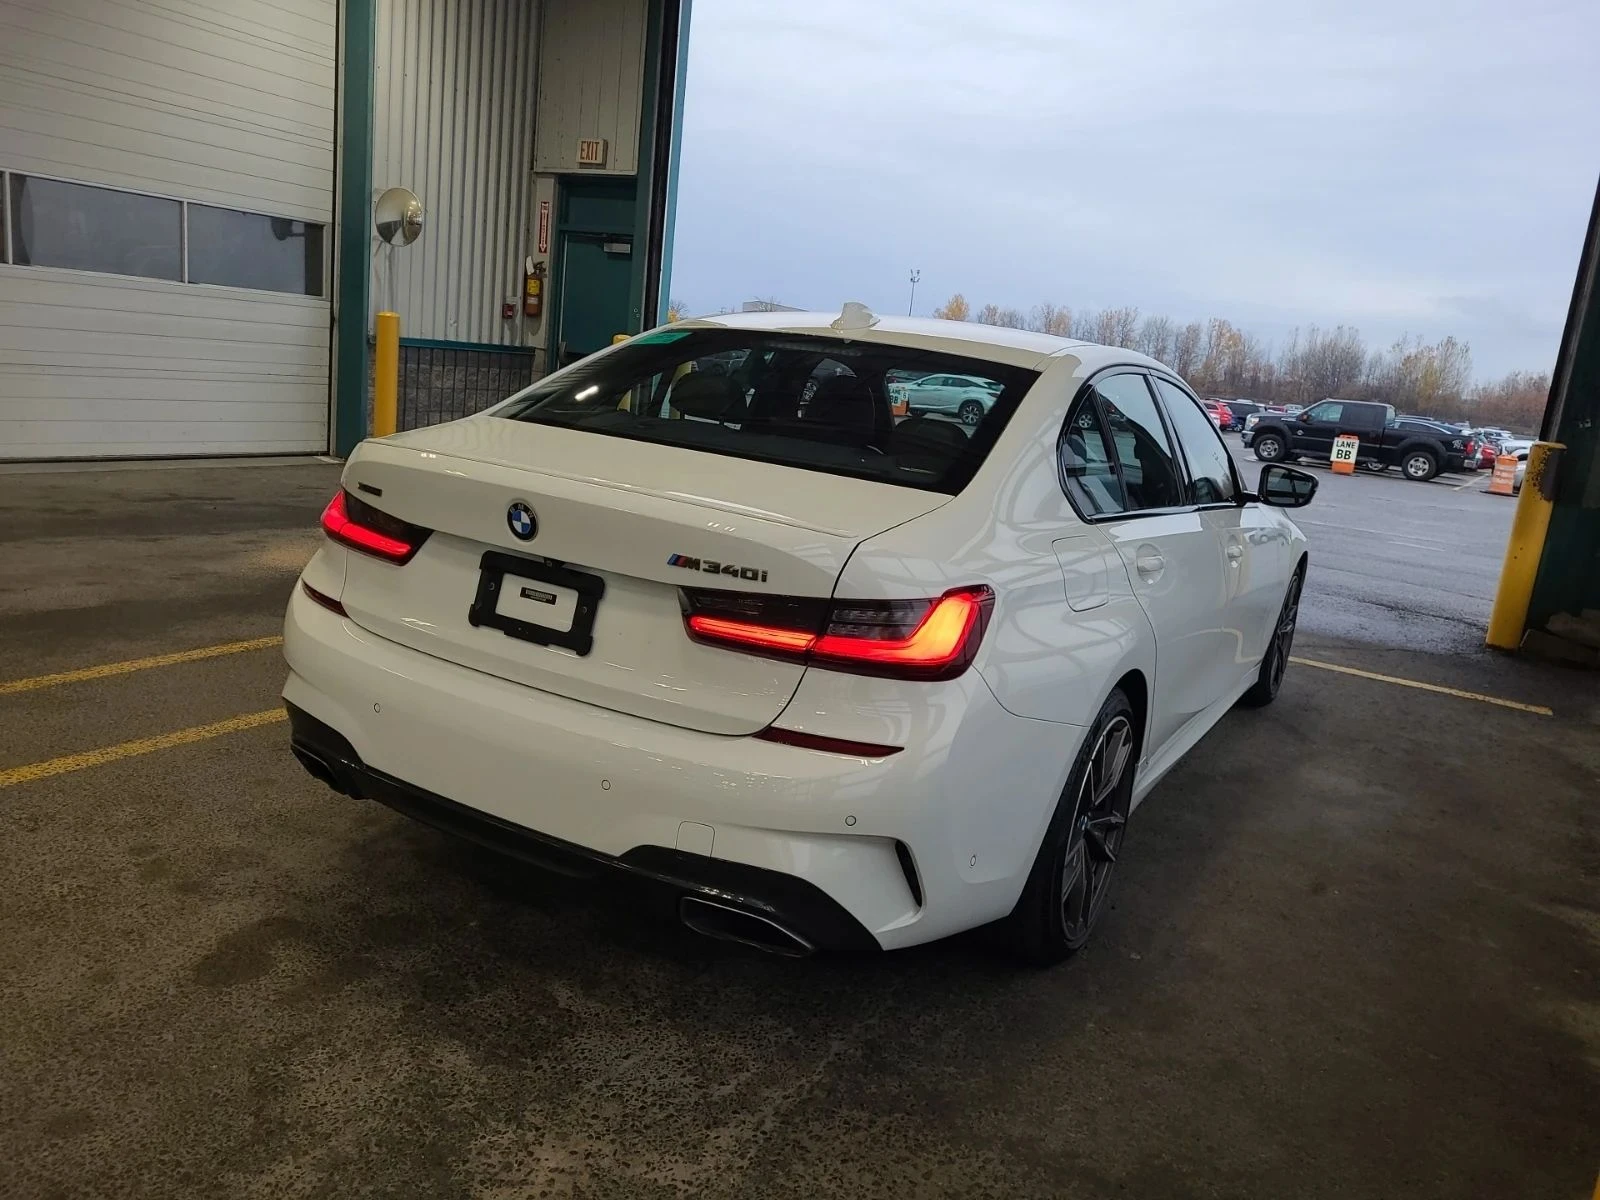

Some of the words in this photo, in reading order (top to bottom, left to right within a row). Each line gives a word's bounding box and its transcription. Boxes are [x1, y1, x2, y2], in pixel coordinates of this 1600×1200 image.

[580, 140, 600, 161] EXIT
[1336, 440, 1357, 449] LANE
[1336, 449, 1352, 460] BB
[682, 556, 768, 583] M340i
